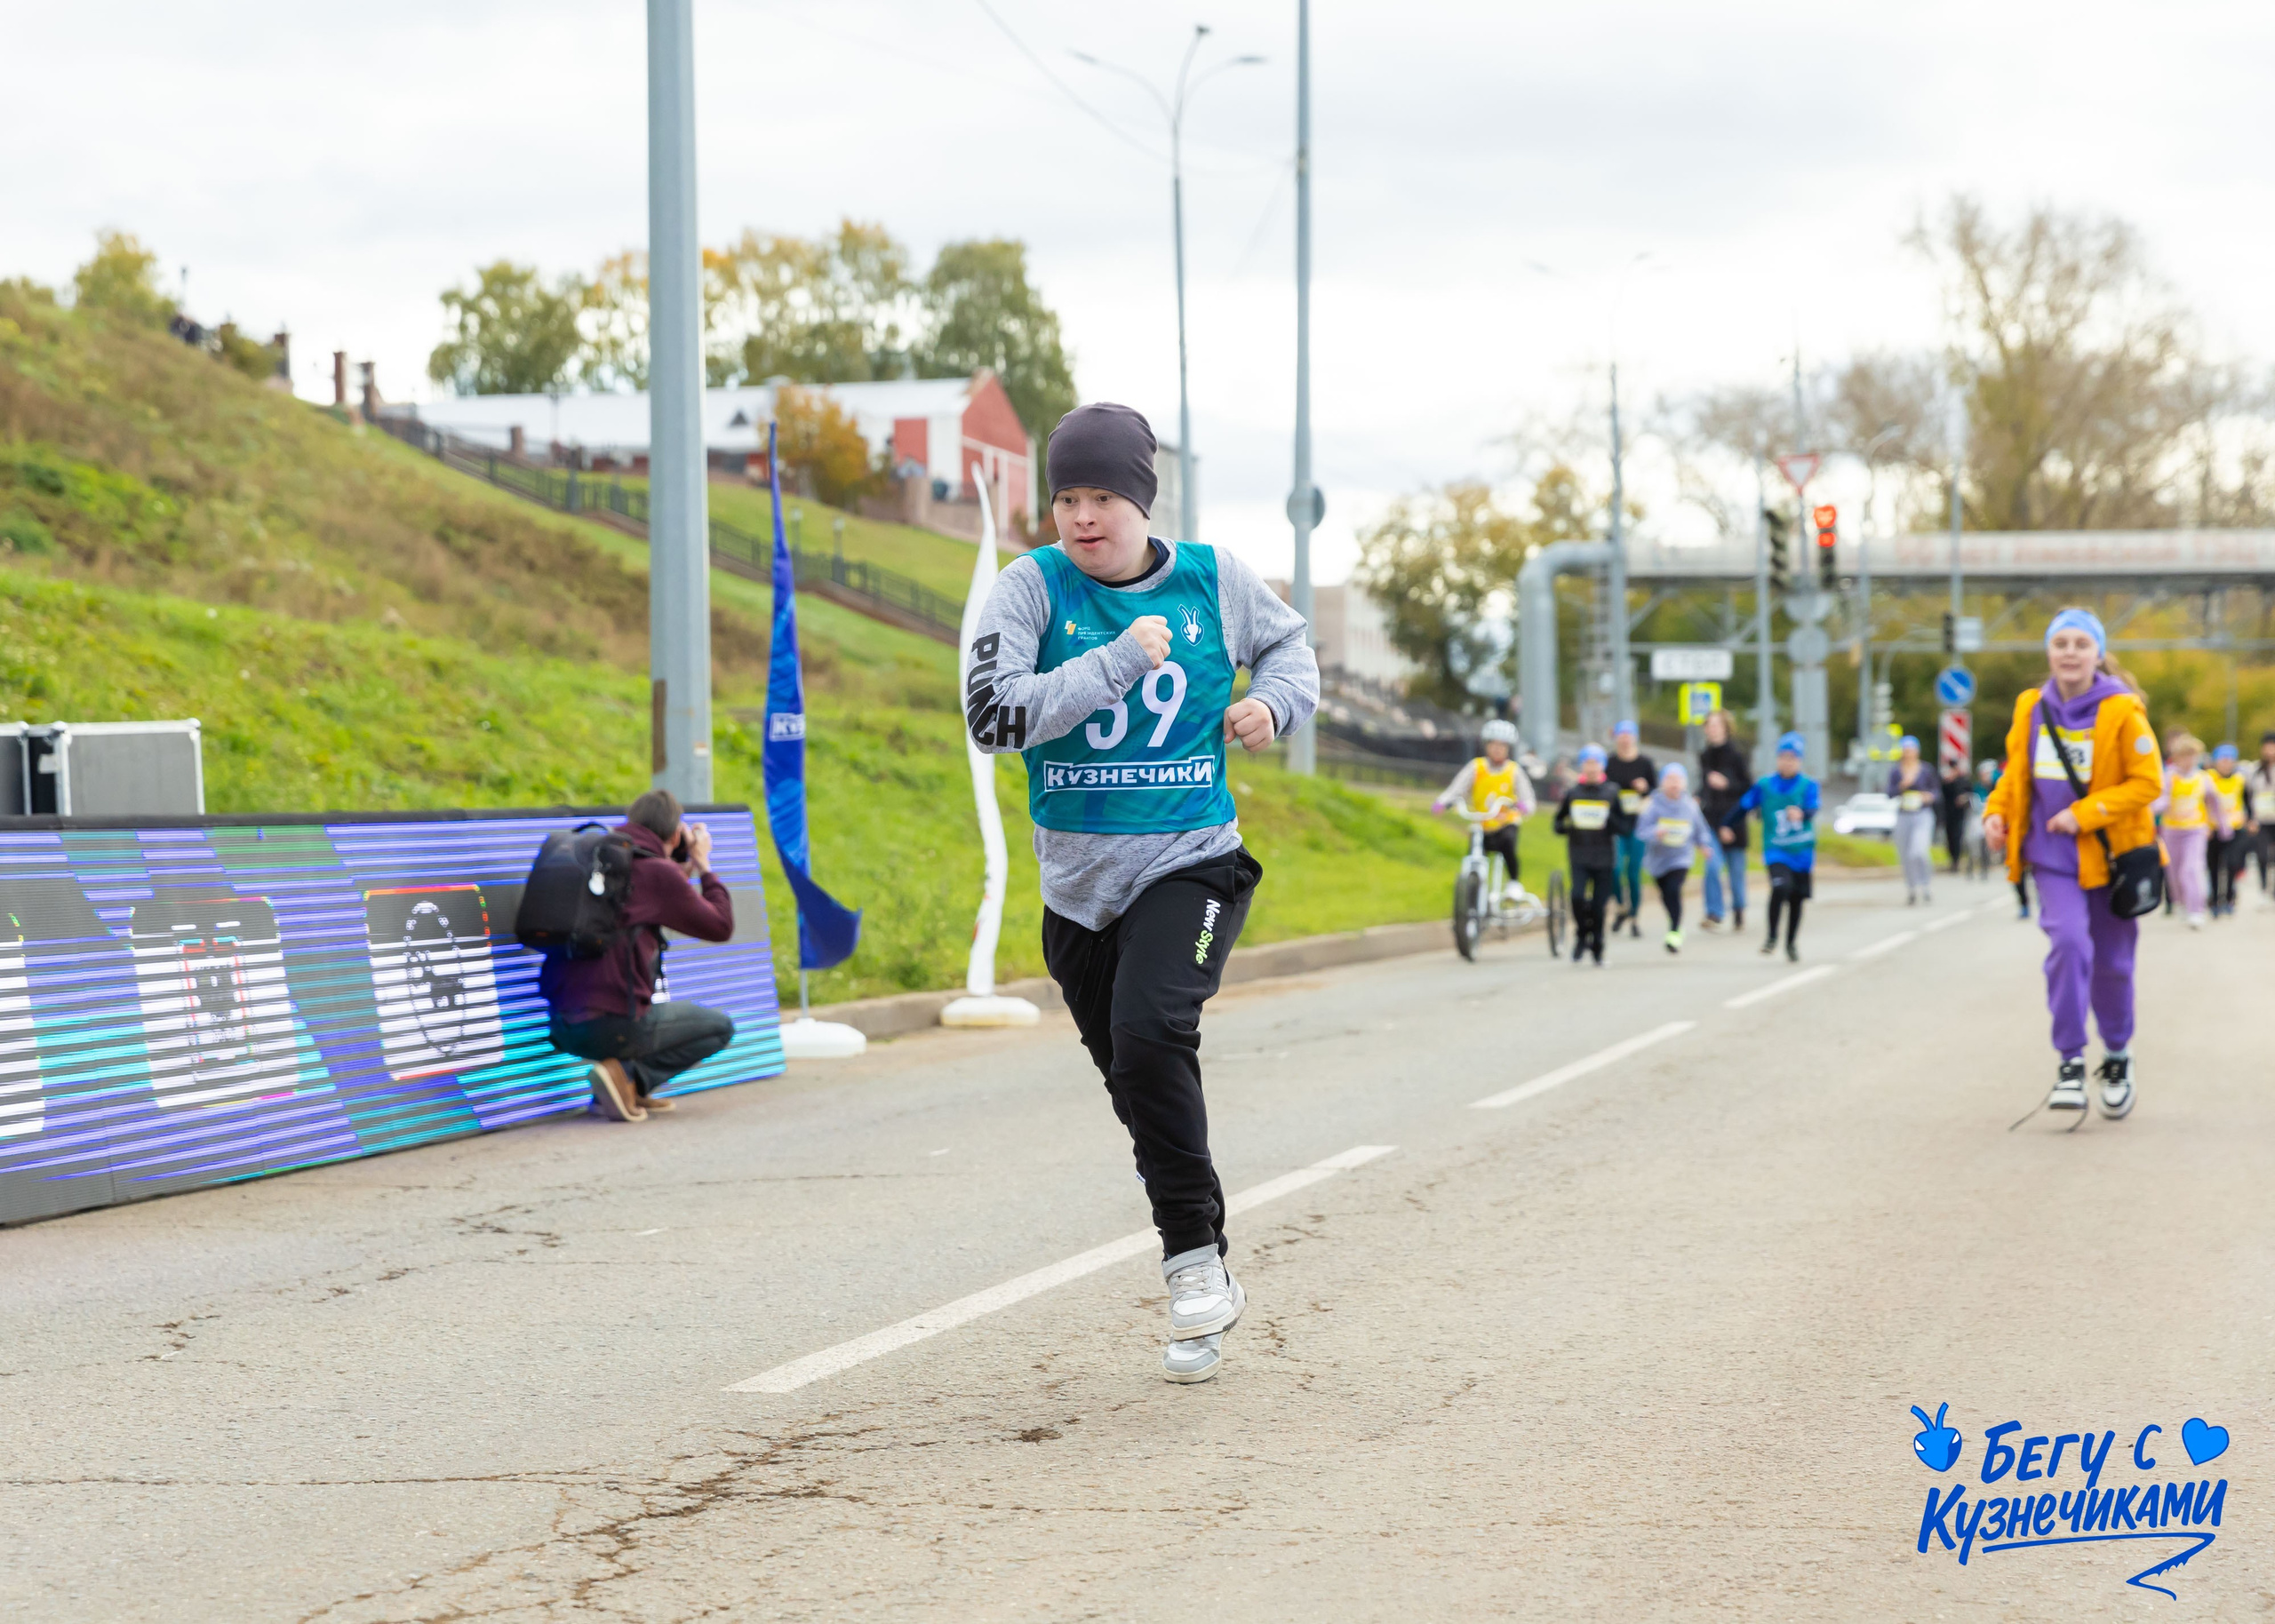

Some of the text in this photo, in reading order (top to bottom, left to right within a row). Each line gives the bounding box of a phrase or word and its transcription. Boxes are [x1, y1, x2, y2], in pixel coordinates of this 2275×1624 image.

[967, 632, 1026, 750] PUNCH
[1048, 761, 1213, 788] КУЗНЕЧИКИ
[1194, 898, 1221, 965] New Style
